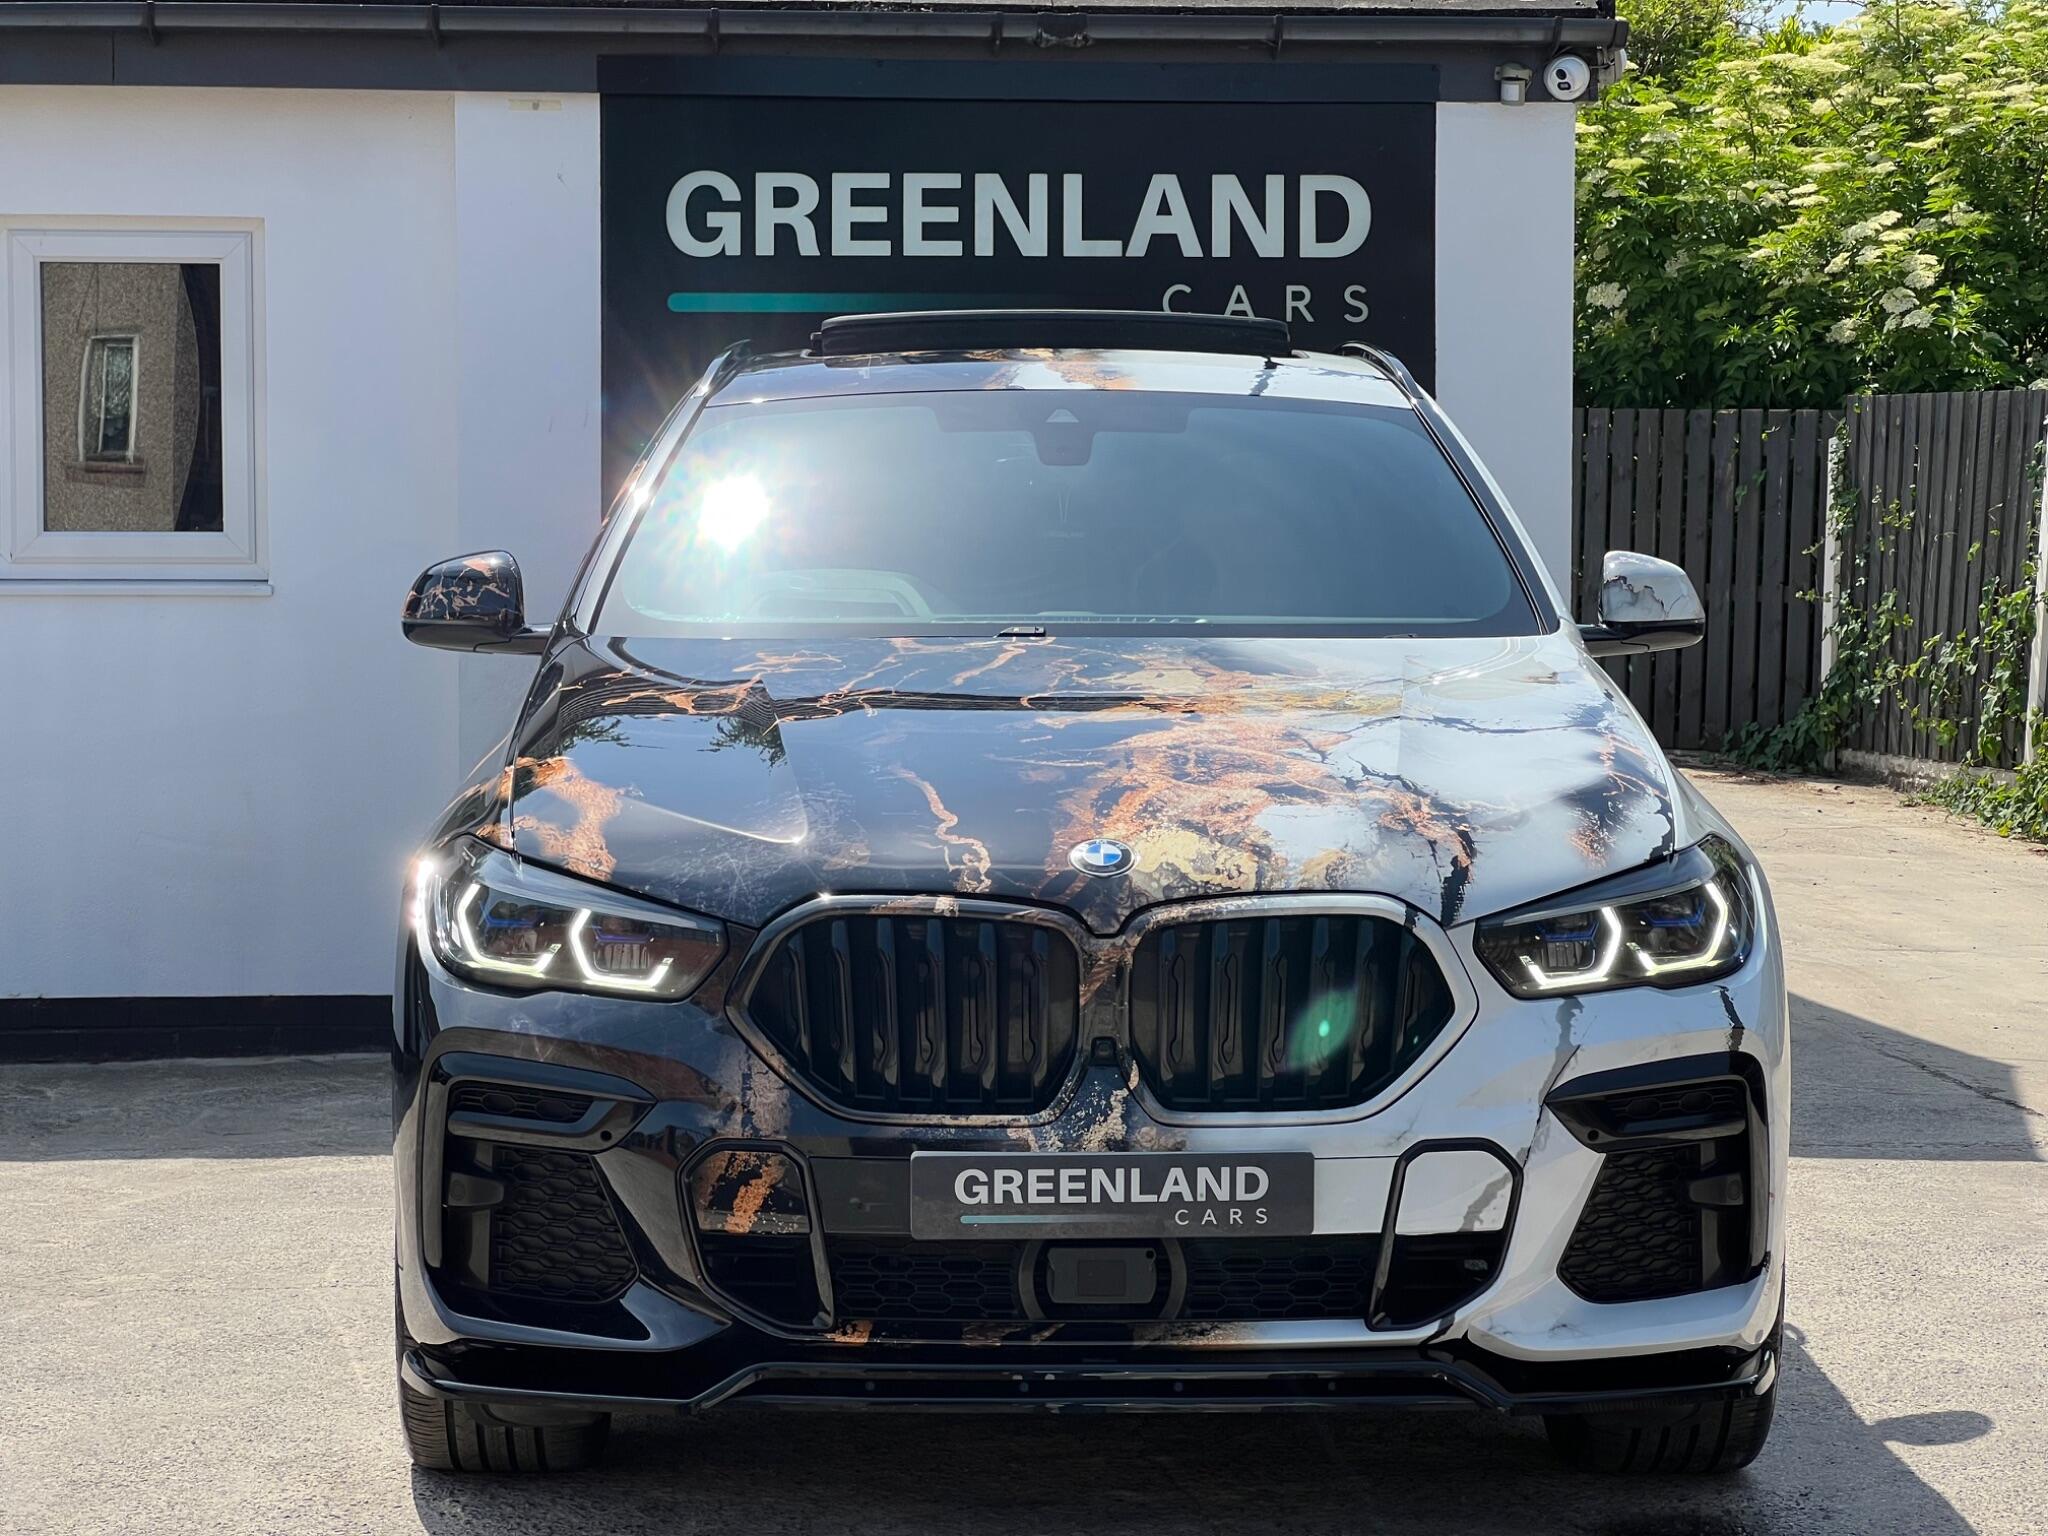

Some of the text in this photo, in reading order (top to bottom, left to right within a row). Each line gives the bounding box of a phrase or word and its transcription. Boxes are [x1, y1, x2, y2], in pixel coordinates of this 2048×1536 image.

[666, 171, 1372, 257] GREENLAND
[1162, 284, 1369, 323] CARS
[954, 1166, 1270, 1205] GREENLAND
[1174, 1208, 1269, 1226] CARS
